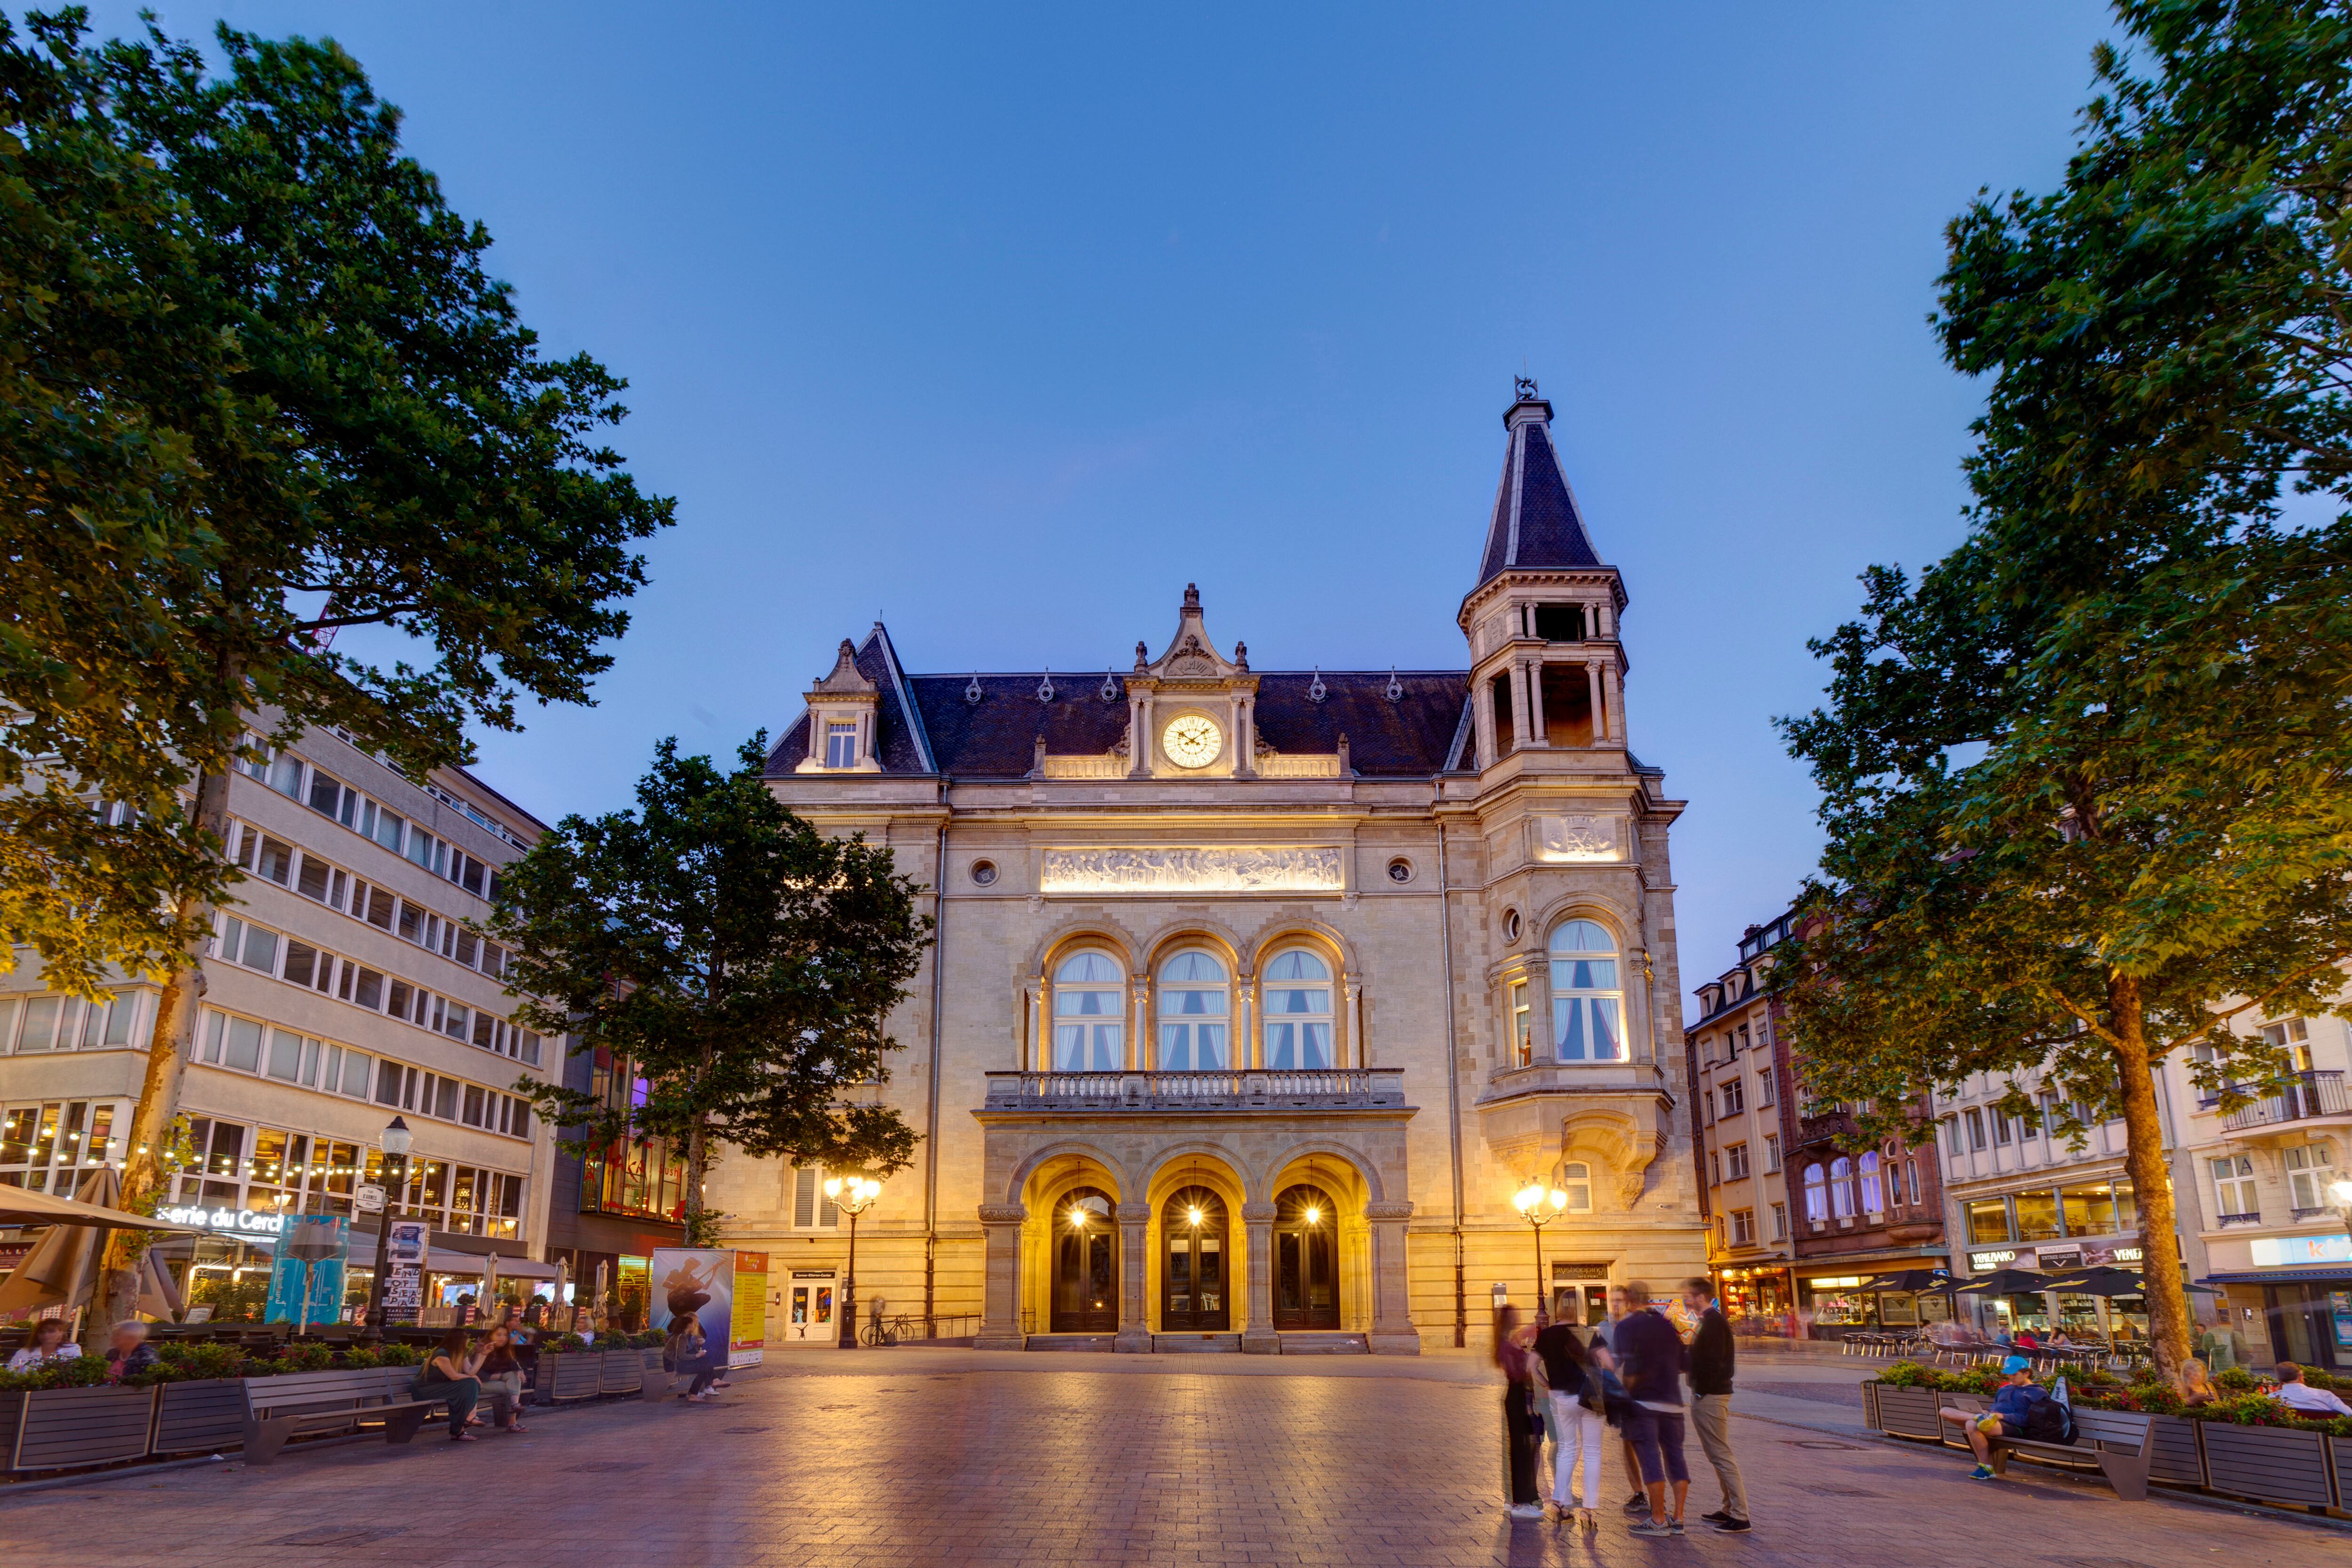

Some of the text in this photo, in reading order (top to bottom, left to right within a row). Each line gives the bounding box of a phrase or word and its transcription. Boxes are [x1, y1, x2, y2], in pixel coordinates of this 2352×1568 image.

[1176, 660, 1208, 673] MCMVII
[211, 1207, 236, 1227] du
[2308, 1240, 2326, 1258] k
[393, 1268, 420, 1277] END
[1553, 1267, 1604, 1275] cityshopping
